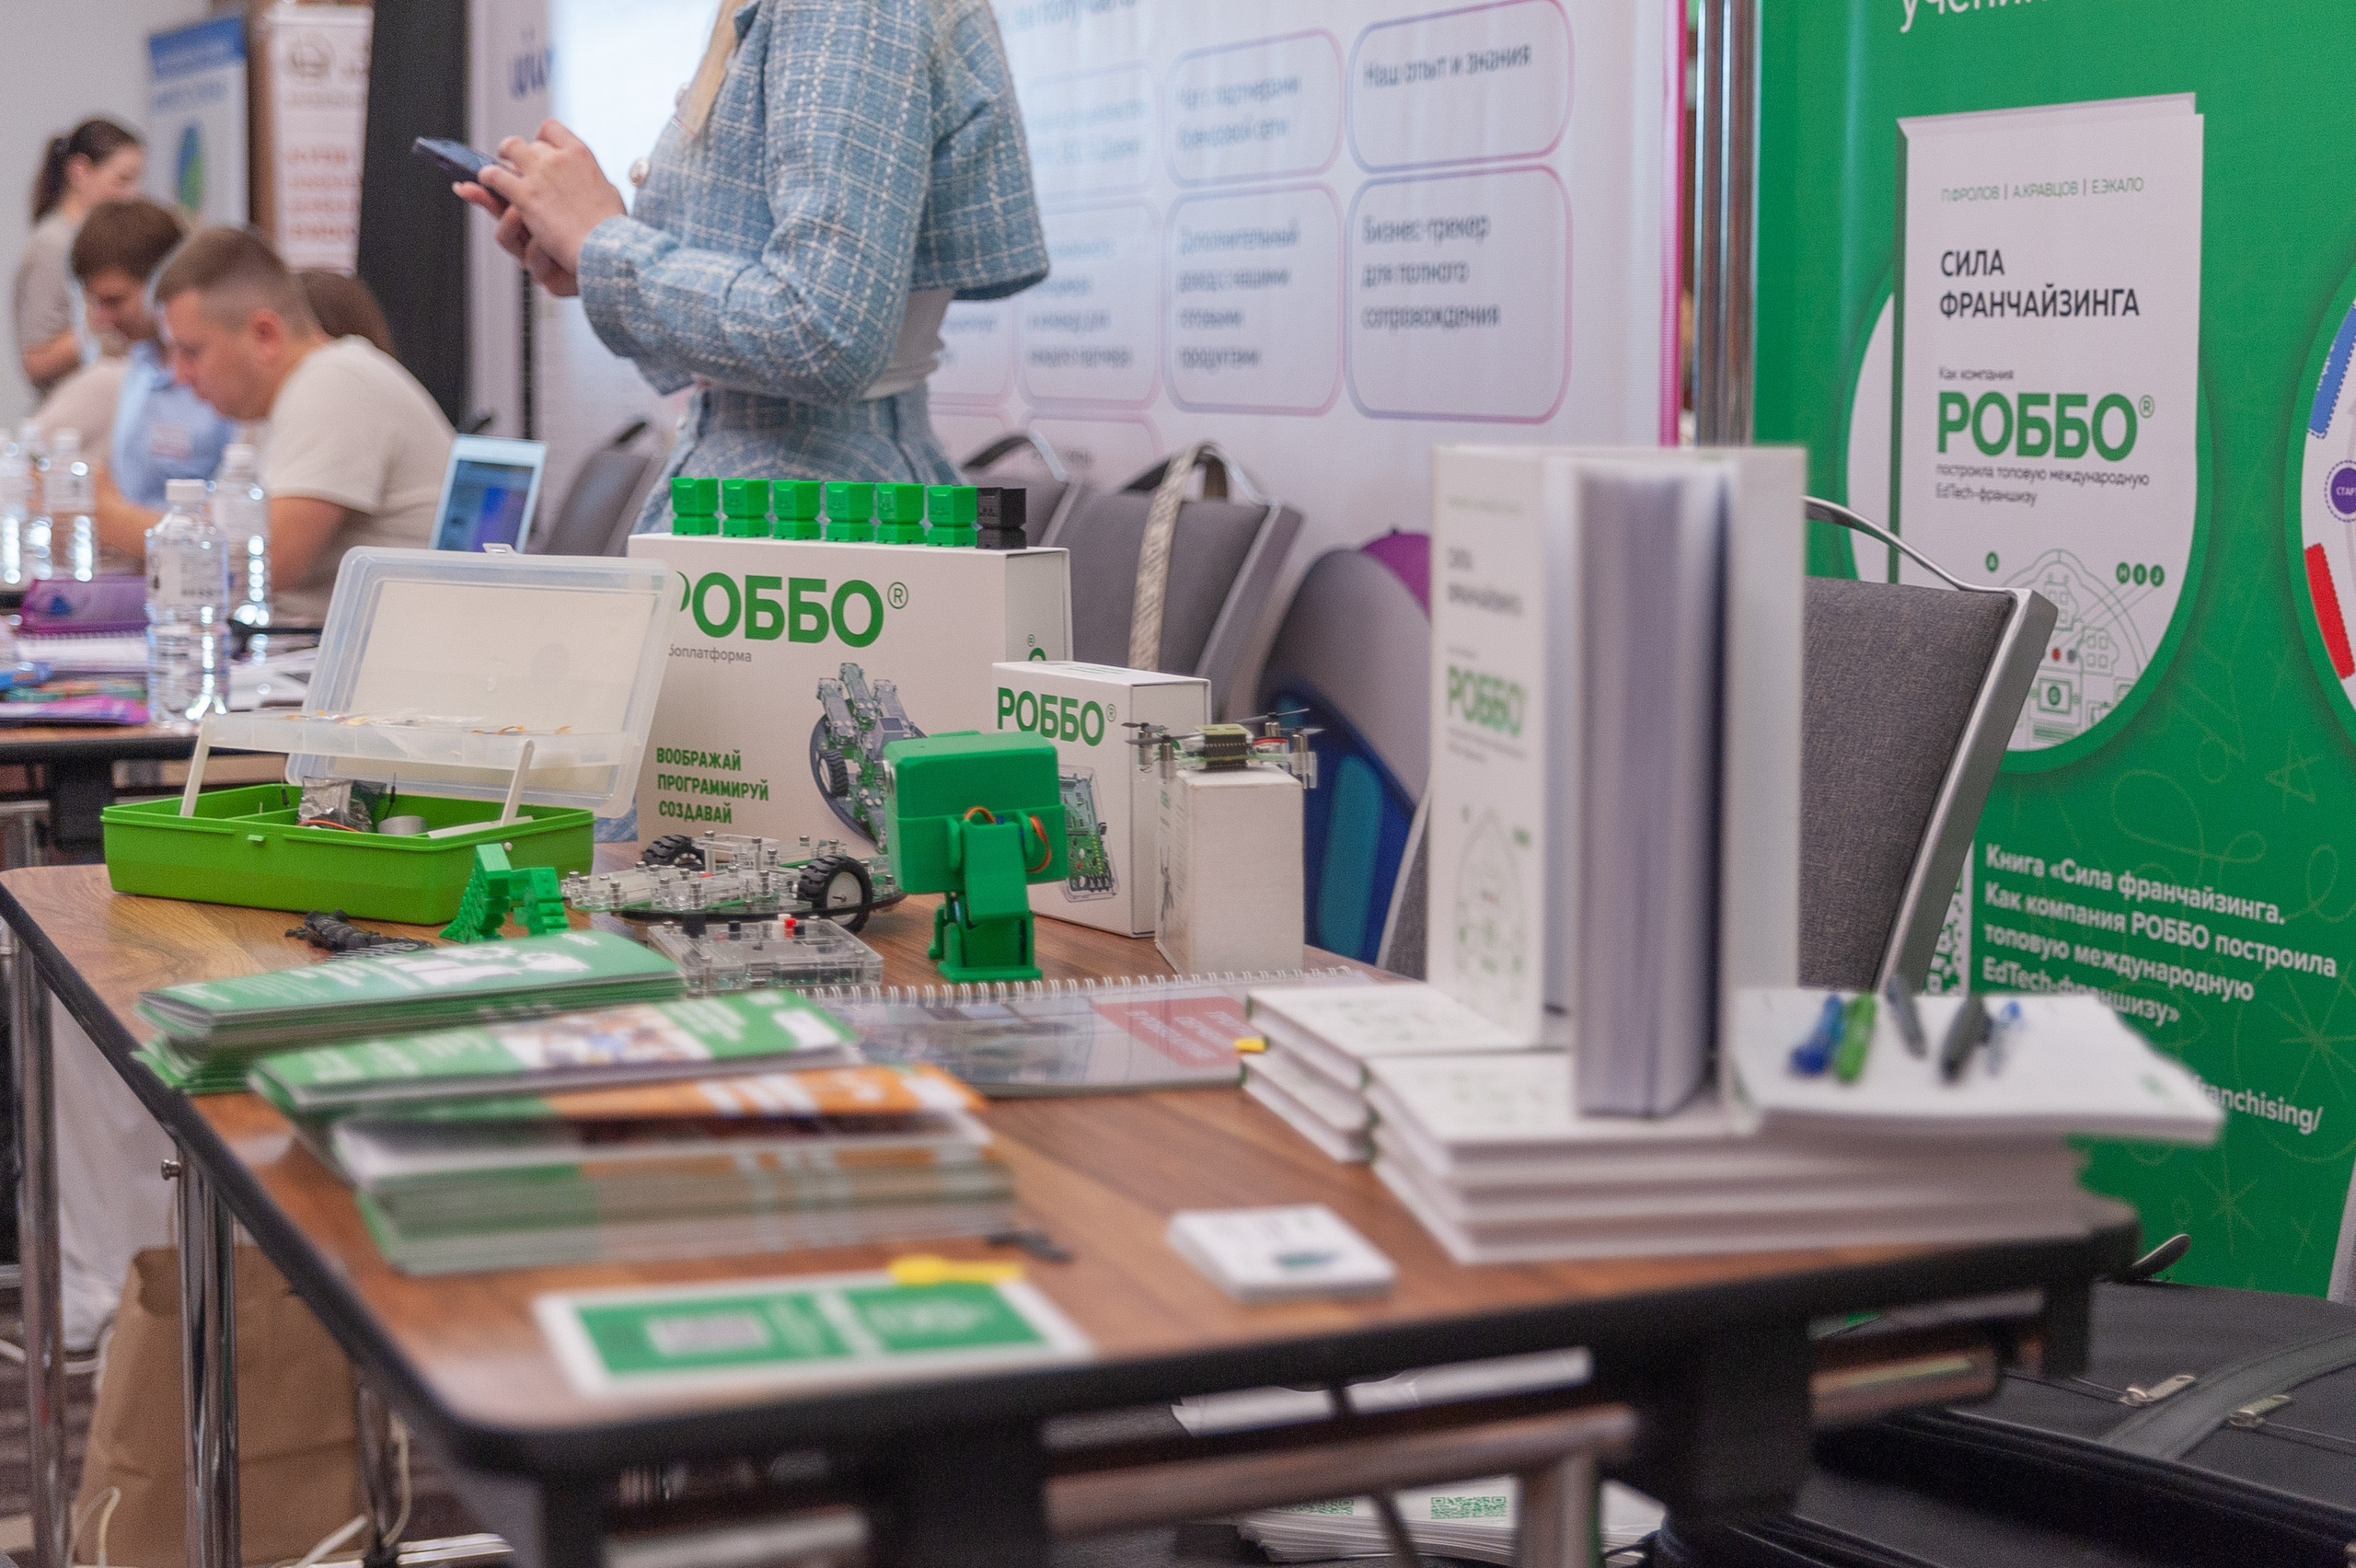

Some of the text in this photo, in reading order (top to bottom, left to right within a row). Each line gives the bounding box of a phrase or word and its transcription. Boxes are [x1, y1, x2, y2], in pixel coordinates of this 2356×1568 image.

[1404, 56, 1445, 82] опыт
[1467, 44, 1531, 75] знания
[1941, 248, 2005, 277] СИЛА
[1940, 282, 2140, 319] ФРАНЧАЙЗИНГА
[1360, 303, 1502, 336] сопровождения
[1939, 368, 2014, 381] Как компания
[2050, 470, 2150, 490] международную
[2336, 486, 2356, 496] СТА
[676, 571, 908, 648] ОББО®
[656, 747, 741, 771] ВООБРАЖАЙ
[657, 774, 769, 801] ПРОГРАММИРУЙ
[659, 800, 733, 824] СОЗДАВАЙ
[1985, 844, 2287, 925] Книга «Сила франчайзинга.
[1984, 882, 2339, 978] Как компания РОББО построила
[1984, 923, 2256, 1003] топовую международную
[2192, 1074, 2324, 1136] anchising/
